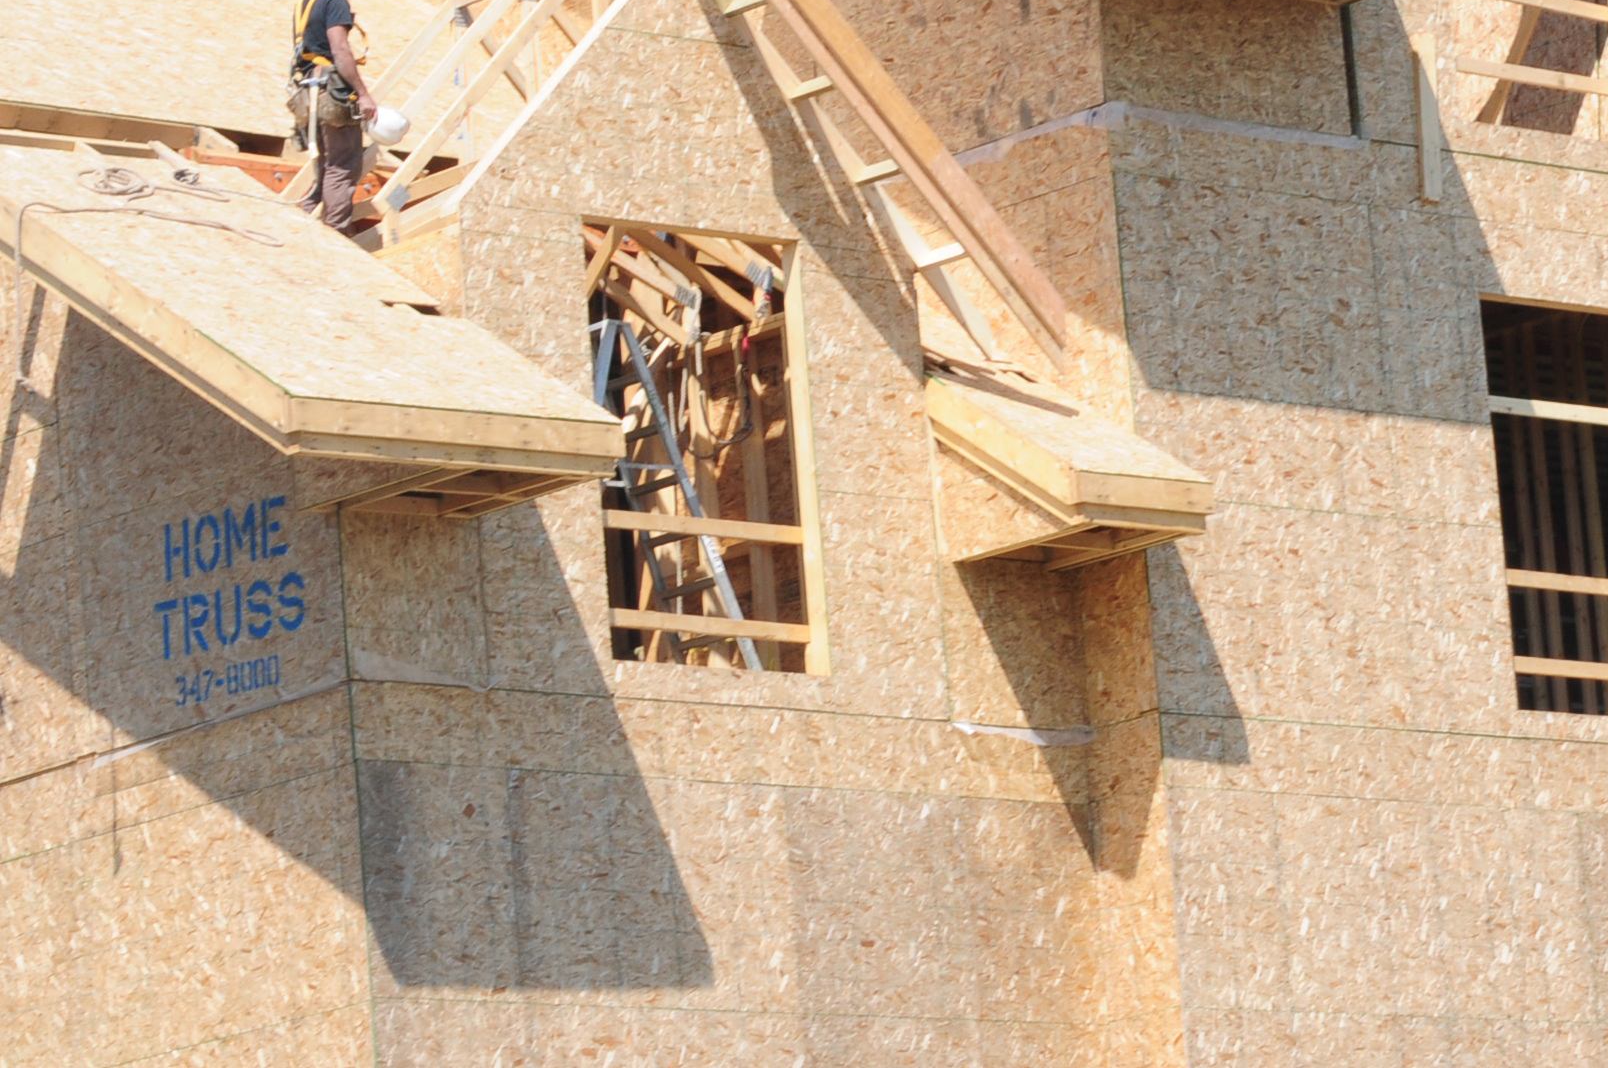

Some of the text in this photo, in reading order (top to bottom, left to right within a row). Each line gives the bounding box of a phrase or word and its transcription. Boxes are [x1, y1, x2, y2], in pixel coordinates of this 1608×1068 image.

[164, 495, 289, 581] HOME
[154, 572, 305, 660] TRUSS
[175, 655, 280, 707] 347-8000
